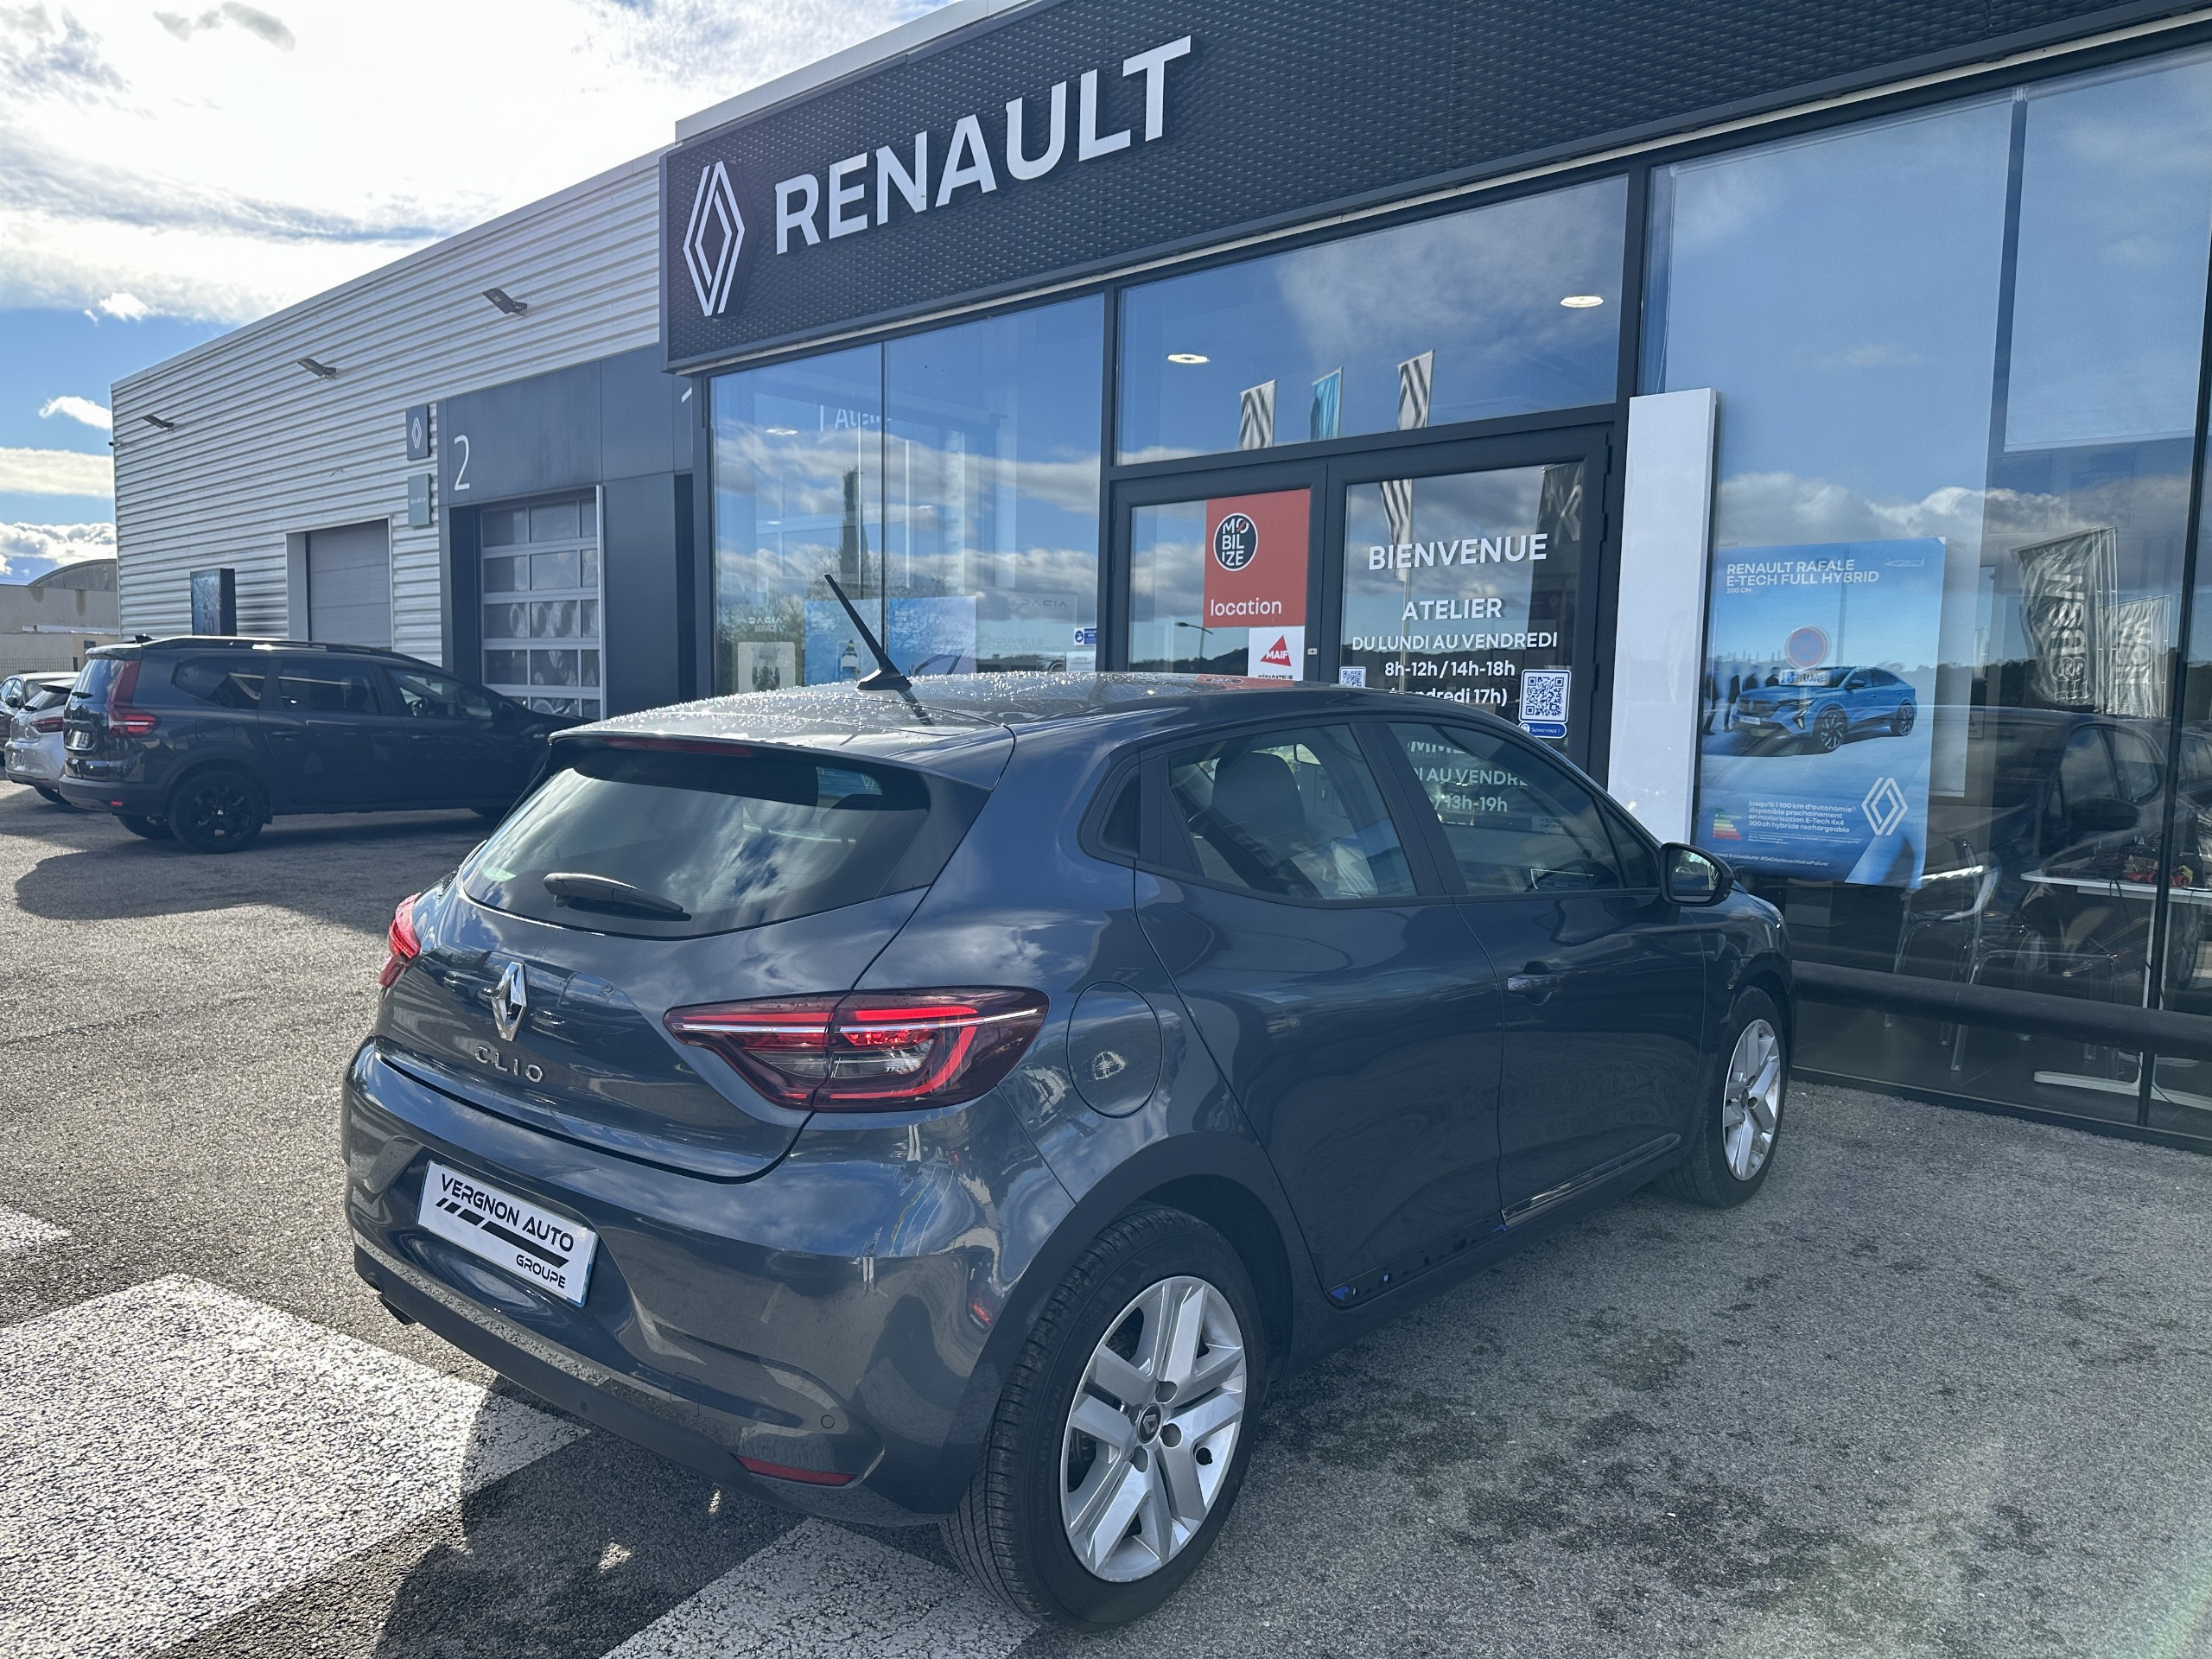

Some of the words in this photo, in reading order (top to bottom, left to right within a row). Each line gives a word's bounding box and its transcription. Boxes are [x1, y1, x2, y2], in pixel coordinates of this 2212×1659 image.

[774, 35, 1192, 255] RENAULT
[454, 435, 471, 491] 2
[1369, 533, 1548, 570] BIENVENUE
[1727, 562, 1794, 575] RENAULT
[1796, 559, 1855, 573] RAFALE
[1726, 574, 1777, 587] E-TECH
[1781, 572, 1818, 585] FULL
[1821, 570, 1879, 584] HYBRID
[1020, 599, 1068, 608] DACIA
[1210, 597, 1282, 616] location
[1402, 597, 1503, 621] ATELIER
[748, 616, 783, 625] DACIA
[754, 624, 778, 632] SERVICE
[988, 637, 1045, 645] NOUVELLE
[1352, 635, 1375, 651] DU
[1378, 634, 1428, 651] LUNDI
[1432, 633, 1458, 649] AU
[1462, 632, 1558, 649] VENDREDI
[1266, 650, 1289, 660] MAIF
[1384, 661, 1438, 677] 8h-12h
[1439, 660, 1449, 678] /
[1451, 659, 1516, 677] 14h-18h
[1473, 687, 1508, 706] 17h)
[1426, 767, 1452, 782] AU
[1445, 794, 1508, 812] 13h-19h
[1805, 803, 1852, 812] d'autonomie
[1758, 815, 1804, 823] motorisation
[1785, 810, 1843, 819] prochainement
[1771, 821, 1799, 830] hybride
[1800, 823, 1851, 833] rechargeable
[474, 1046, 543, 1083] CLIO
[441, 1173, 520, 1227] VERGNON
[521, 1215, 574, 1253] AUTO
[516, 1254, 567, 1290] GROUPE
